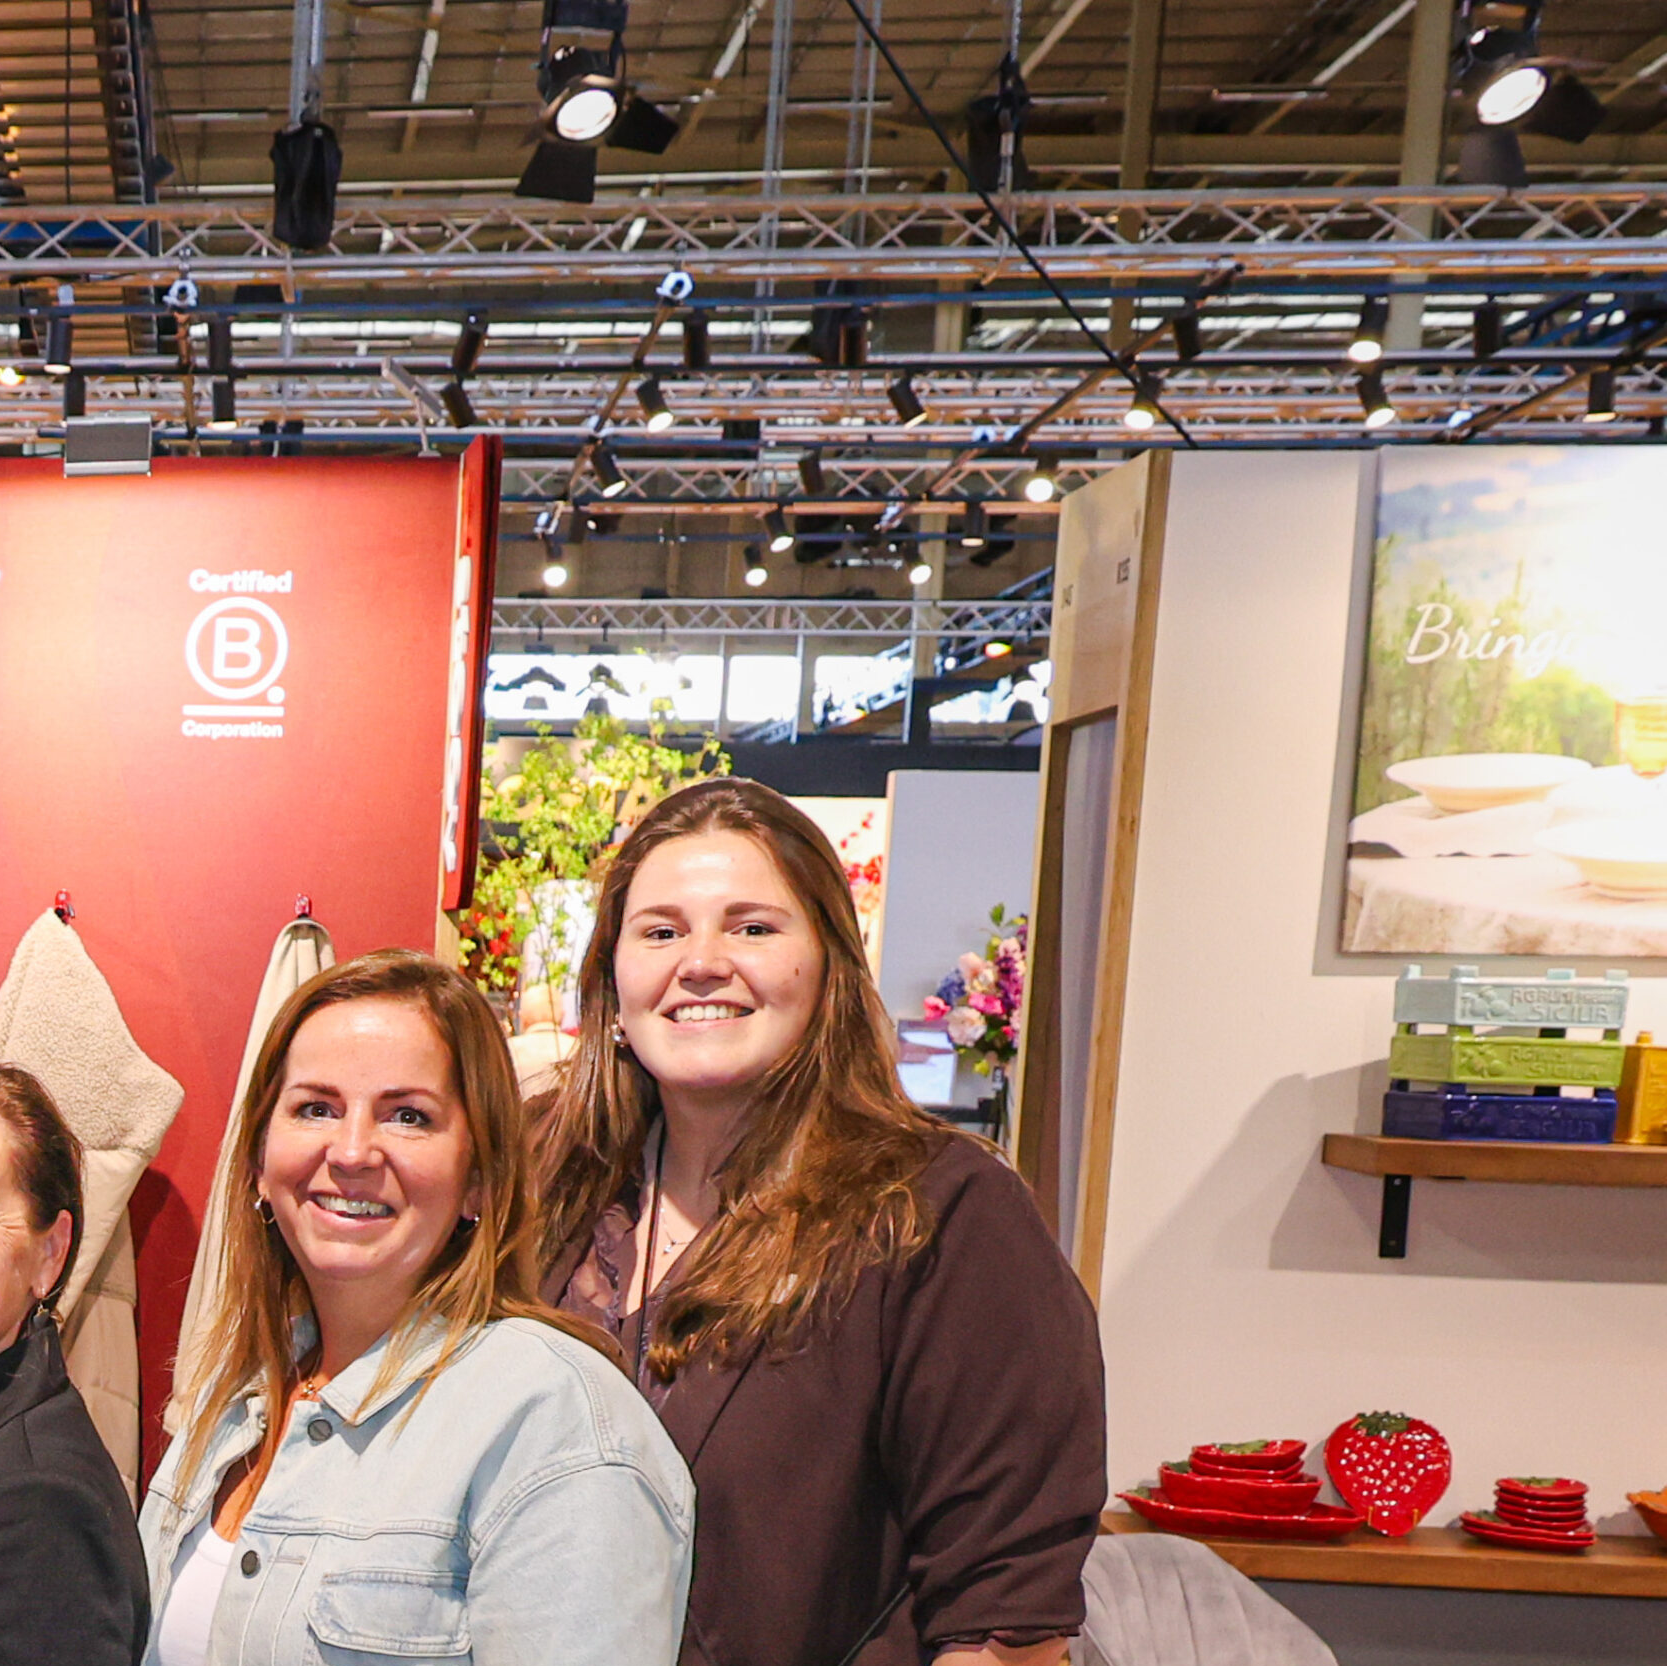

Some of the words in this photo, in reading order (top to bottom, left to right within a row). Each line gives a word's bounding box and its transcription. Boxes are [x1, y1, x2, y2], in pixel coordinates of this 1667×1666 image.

[188, 568, 293, 593] Certified
[212, 617, 263, 679] B
[181, 719, 284, 740] Corporation
